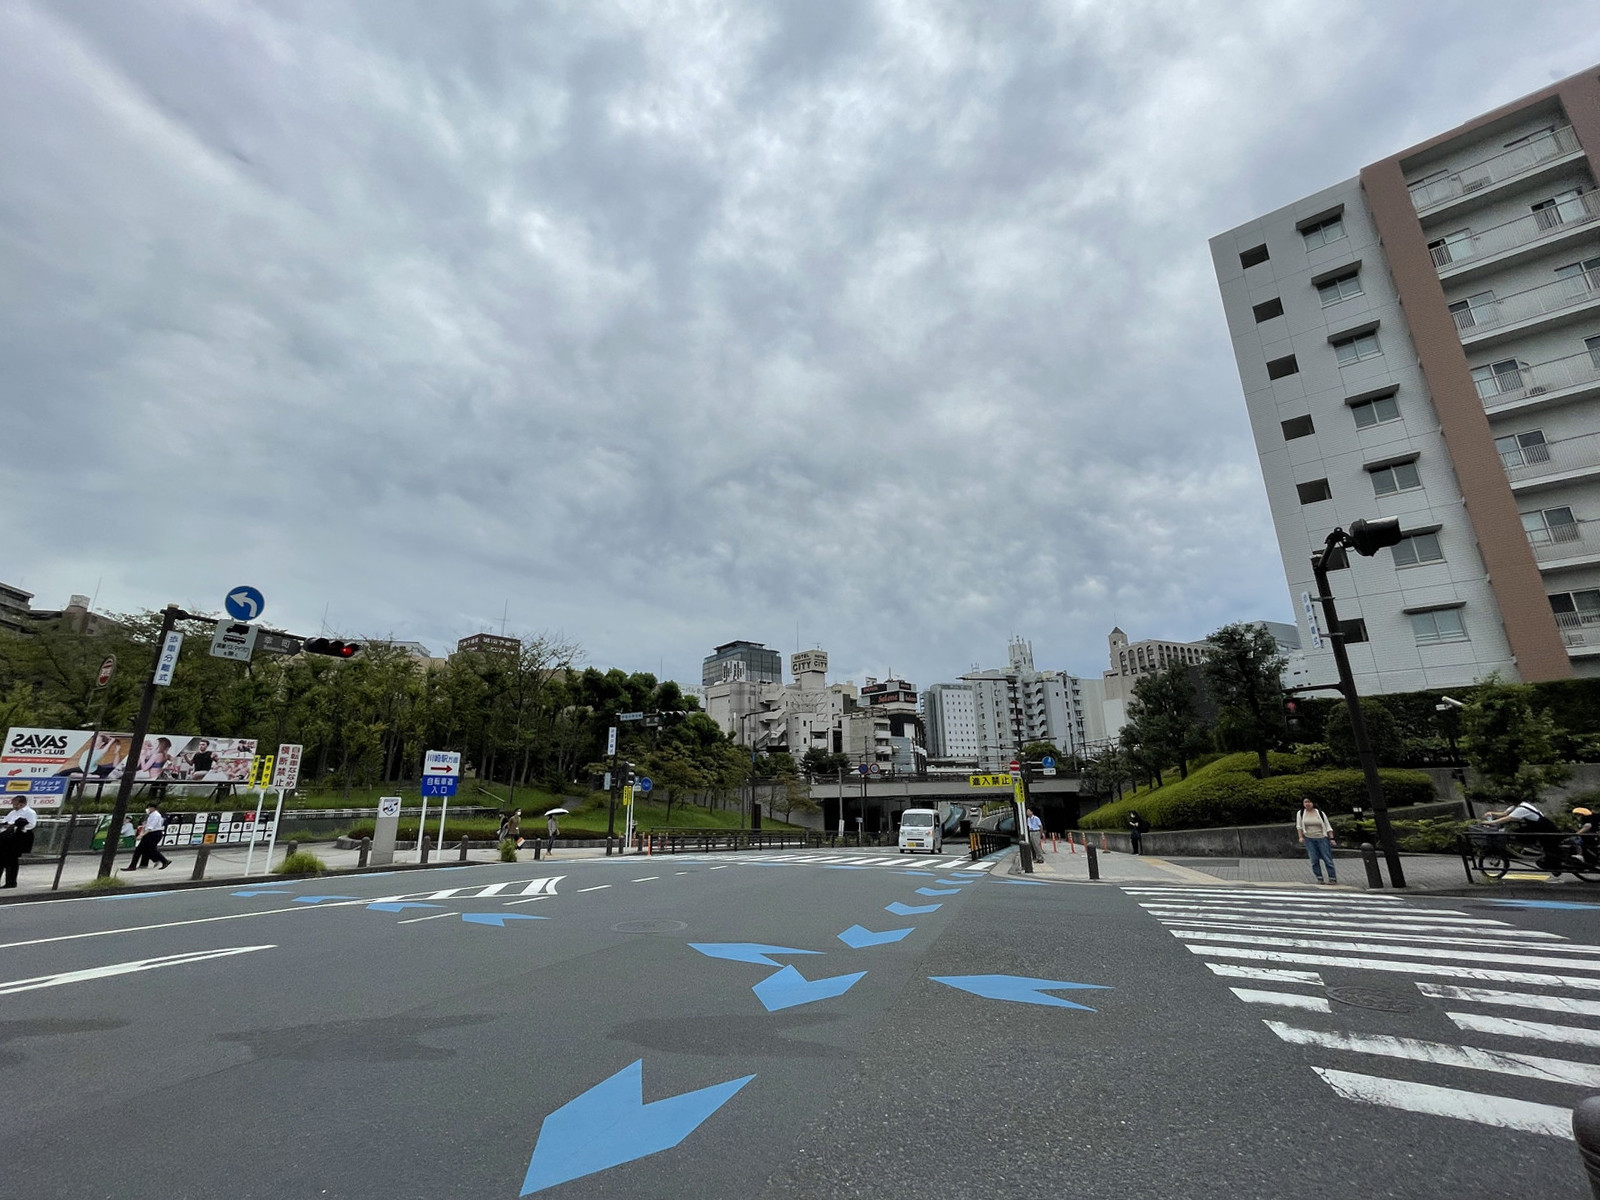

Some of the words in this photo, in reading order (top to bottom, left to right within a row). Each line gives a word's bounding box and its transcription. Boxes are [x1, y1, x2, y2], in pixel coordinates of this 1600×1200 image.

[158, 635, 178, 682] 歩車分離式
[793, 661, 811, 672] CITY
[11, 734, 68, 749] SAVAS
[275, 746, 290, 787] 横断禁止
[285, 747, 300, 787] 自転車ななめ
[972, 776, 1010, 786] 進入禁止
[431, 786, 448, 794] 入口
